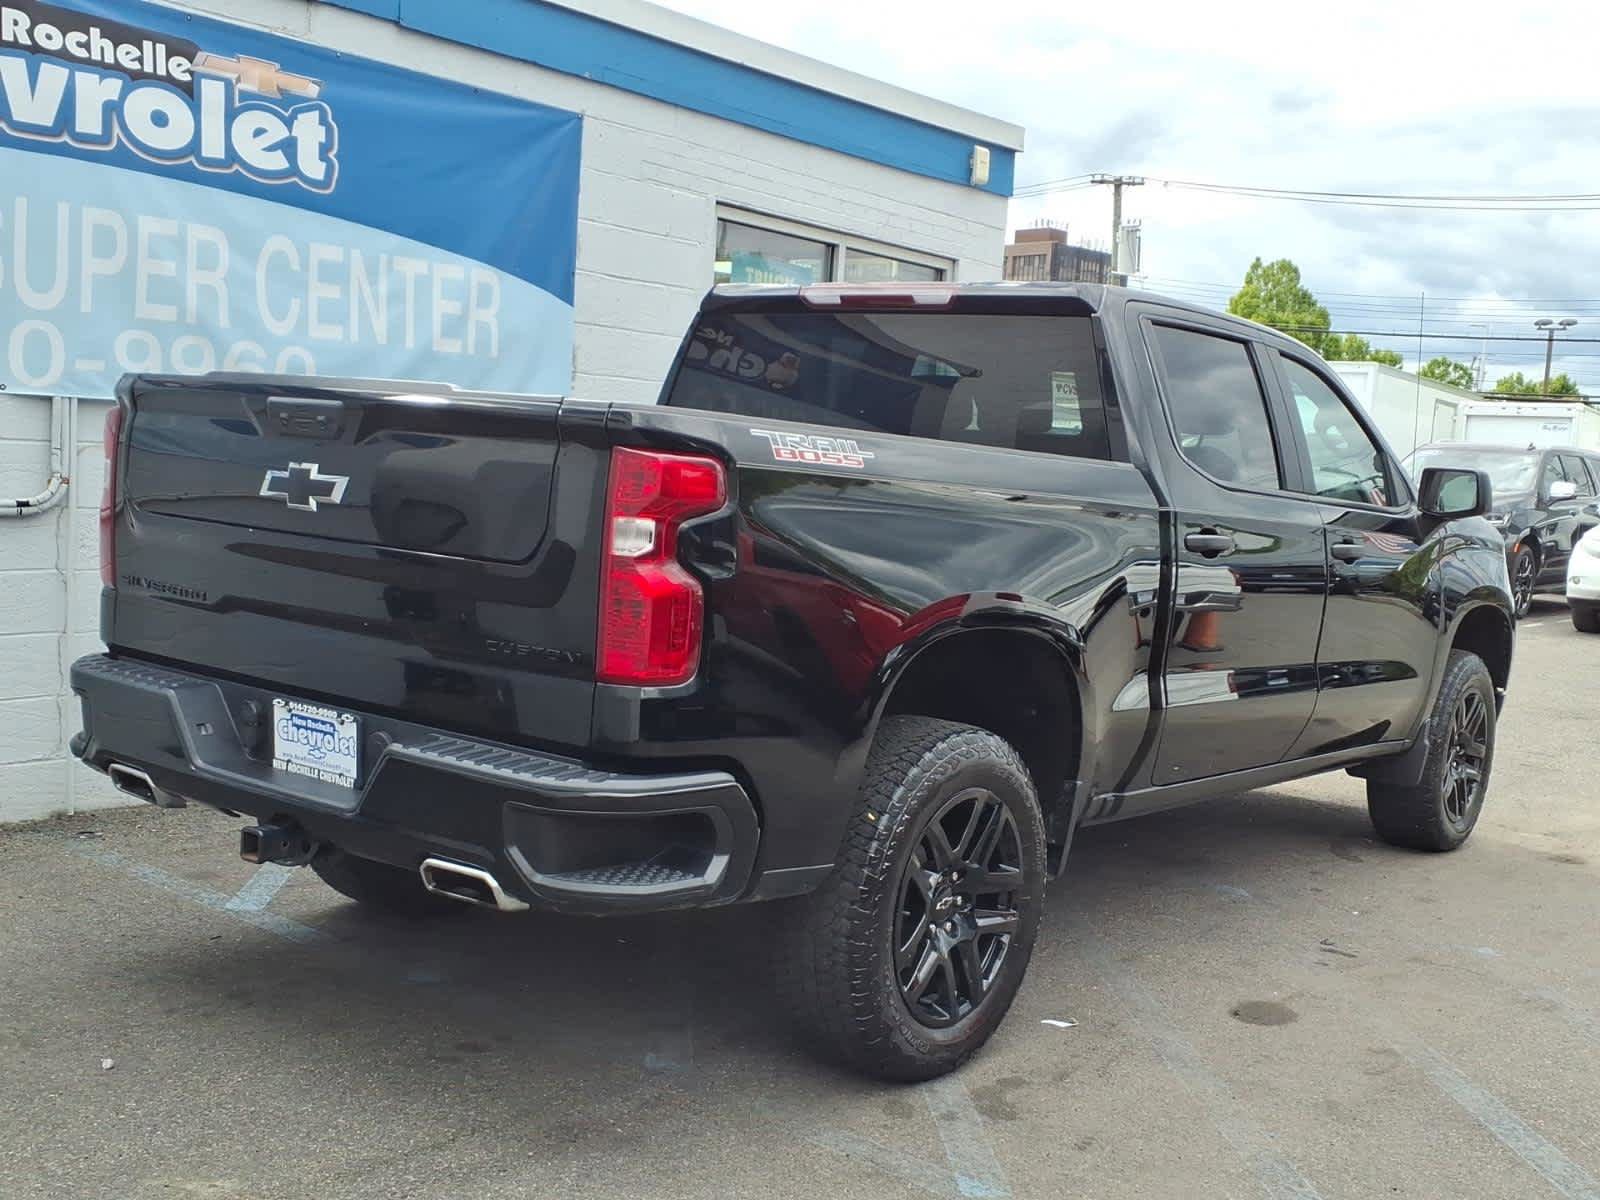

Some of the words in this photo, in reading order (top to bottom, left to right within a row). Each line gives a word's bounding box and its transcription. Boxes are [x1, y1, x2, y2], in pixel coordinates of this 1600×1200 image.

[1, 7, 193, 81] Rochelle
[0, 196, 231, 329] UPER
[255, 234, 500, 357] CENTER
[750, 428, 875, 459] TRAIL
[773, 447, 865, 468] BOSS
[277, 717, 356, 759] Chevrolet
[273, 758, 287, 771] NEW
[287, 761, 320, 780] ROCHELLE
[319, 770, 354, 789] CHEVROLET
